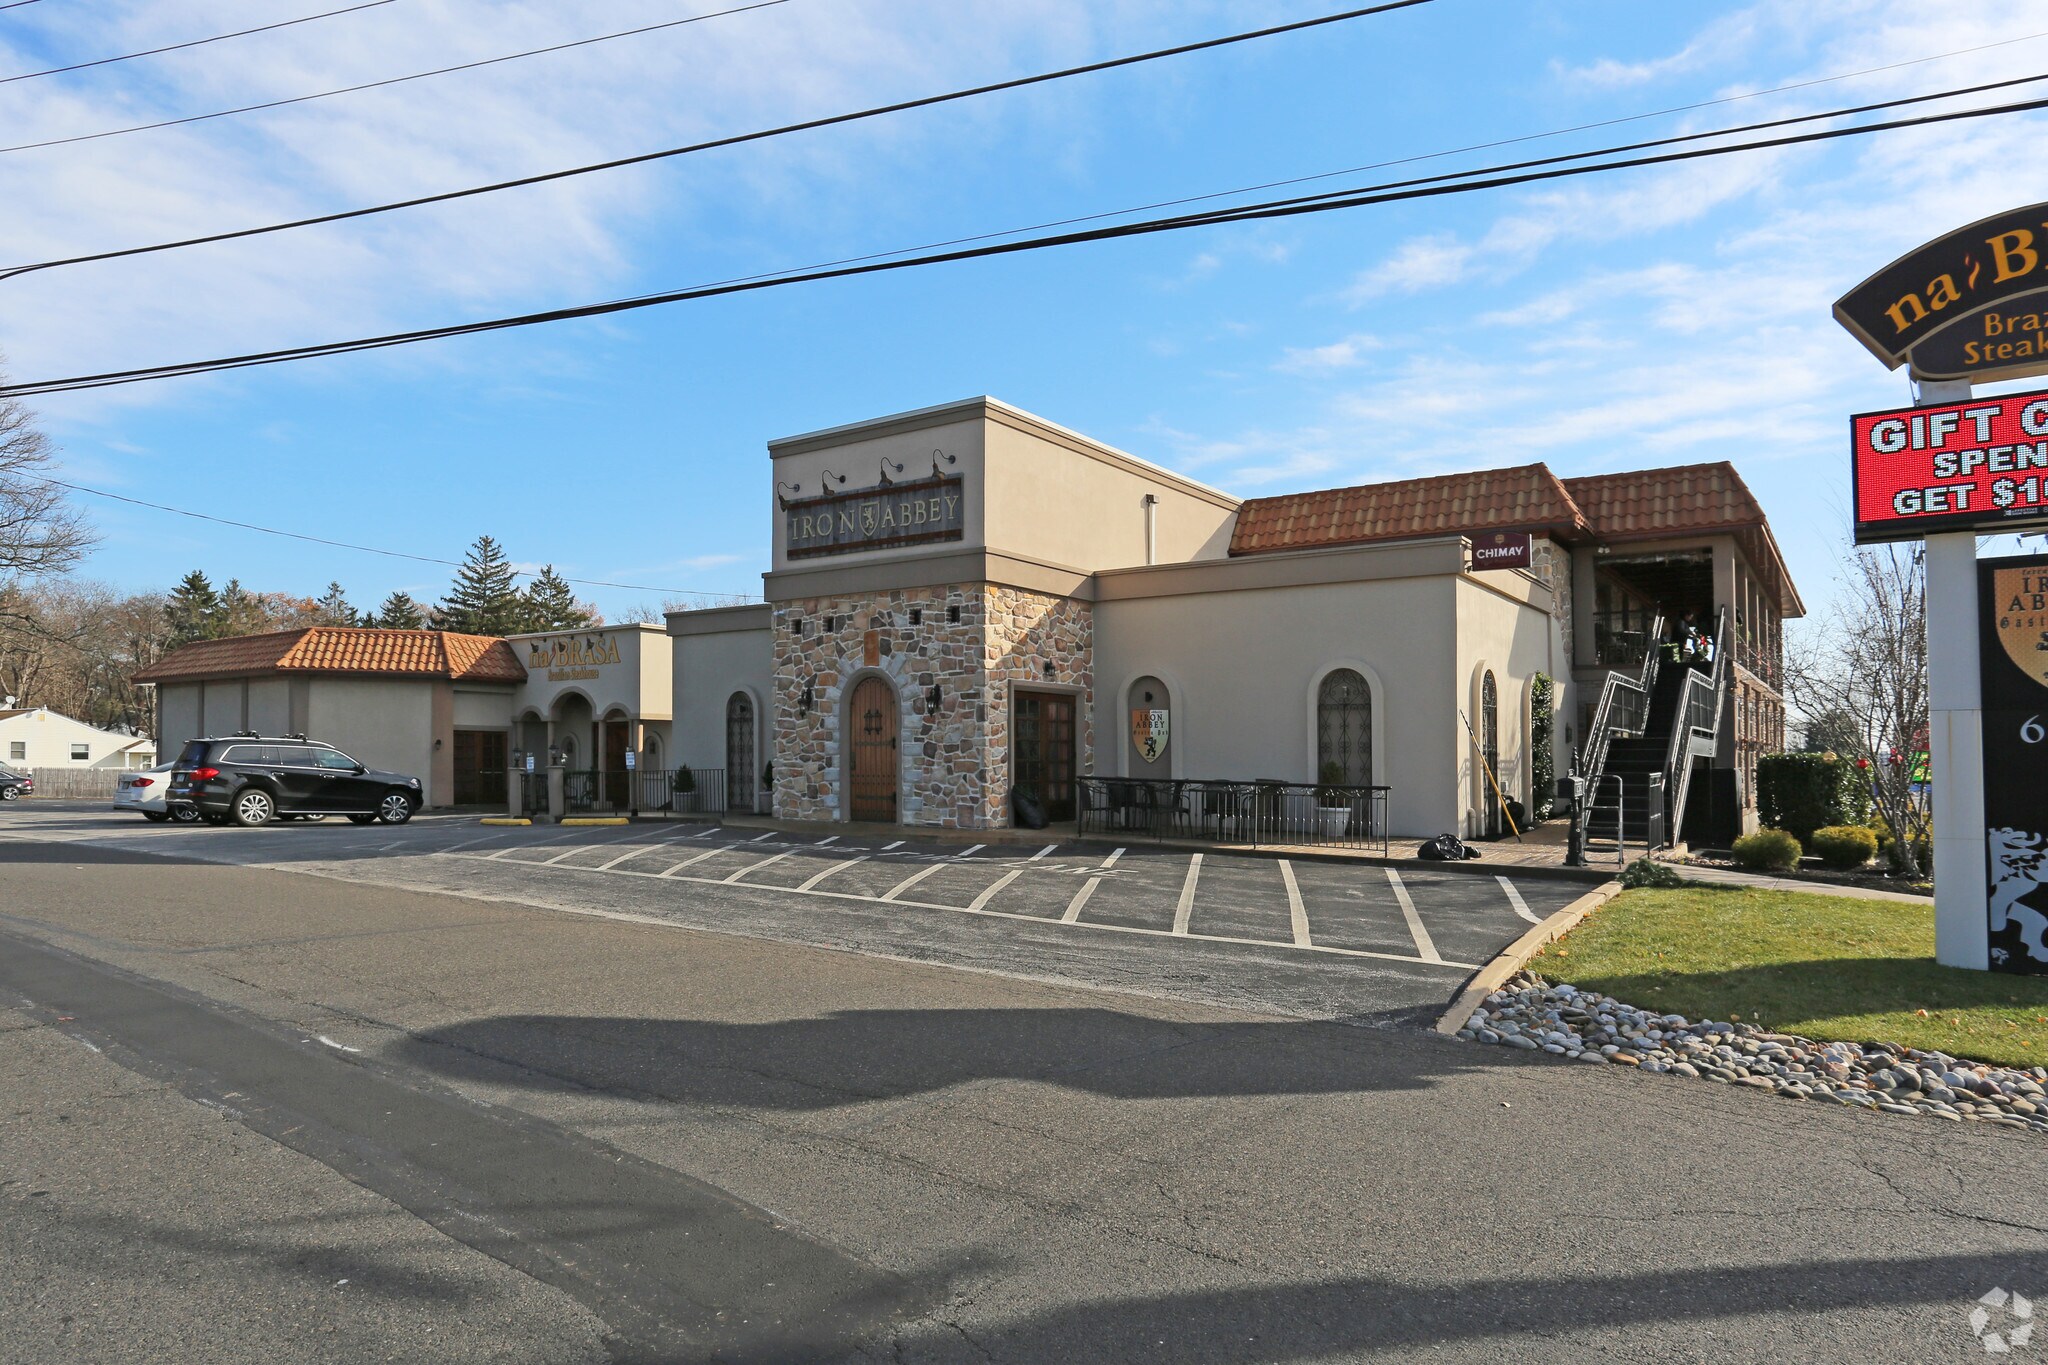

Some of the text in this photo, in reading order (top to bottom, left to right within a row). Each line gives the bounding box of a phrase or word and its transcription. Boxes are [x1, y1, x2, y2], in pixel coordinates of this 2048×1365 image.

[1884, 222, 2048, 334] na B
[1870, 406, 2001, 453] GIFT
[1934, 442, 2048, 478] SPEN
[1893, 477, 2048, 515] GET $1
[791, 496, 959, 540] IRON ABBEY
[1476, 546, 1524, 559] CHIMAY
[2008, 594, 2046, 612] AB
[529, 636, 621, 669] na BRASA
[1135, 721, 1165, 729] ABBEY
[1140, 713, 1163, 721] IRON
[2020, 714, 2045, 744] 6
